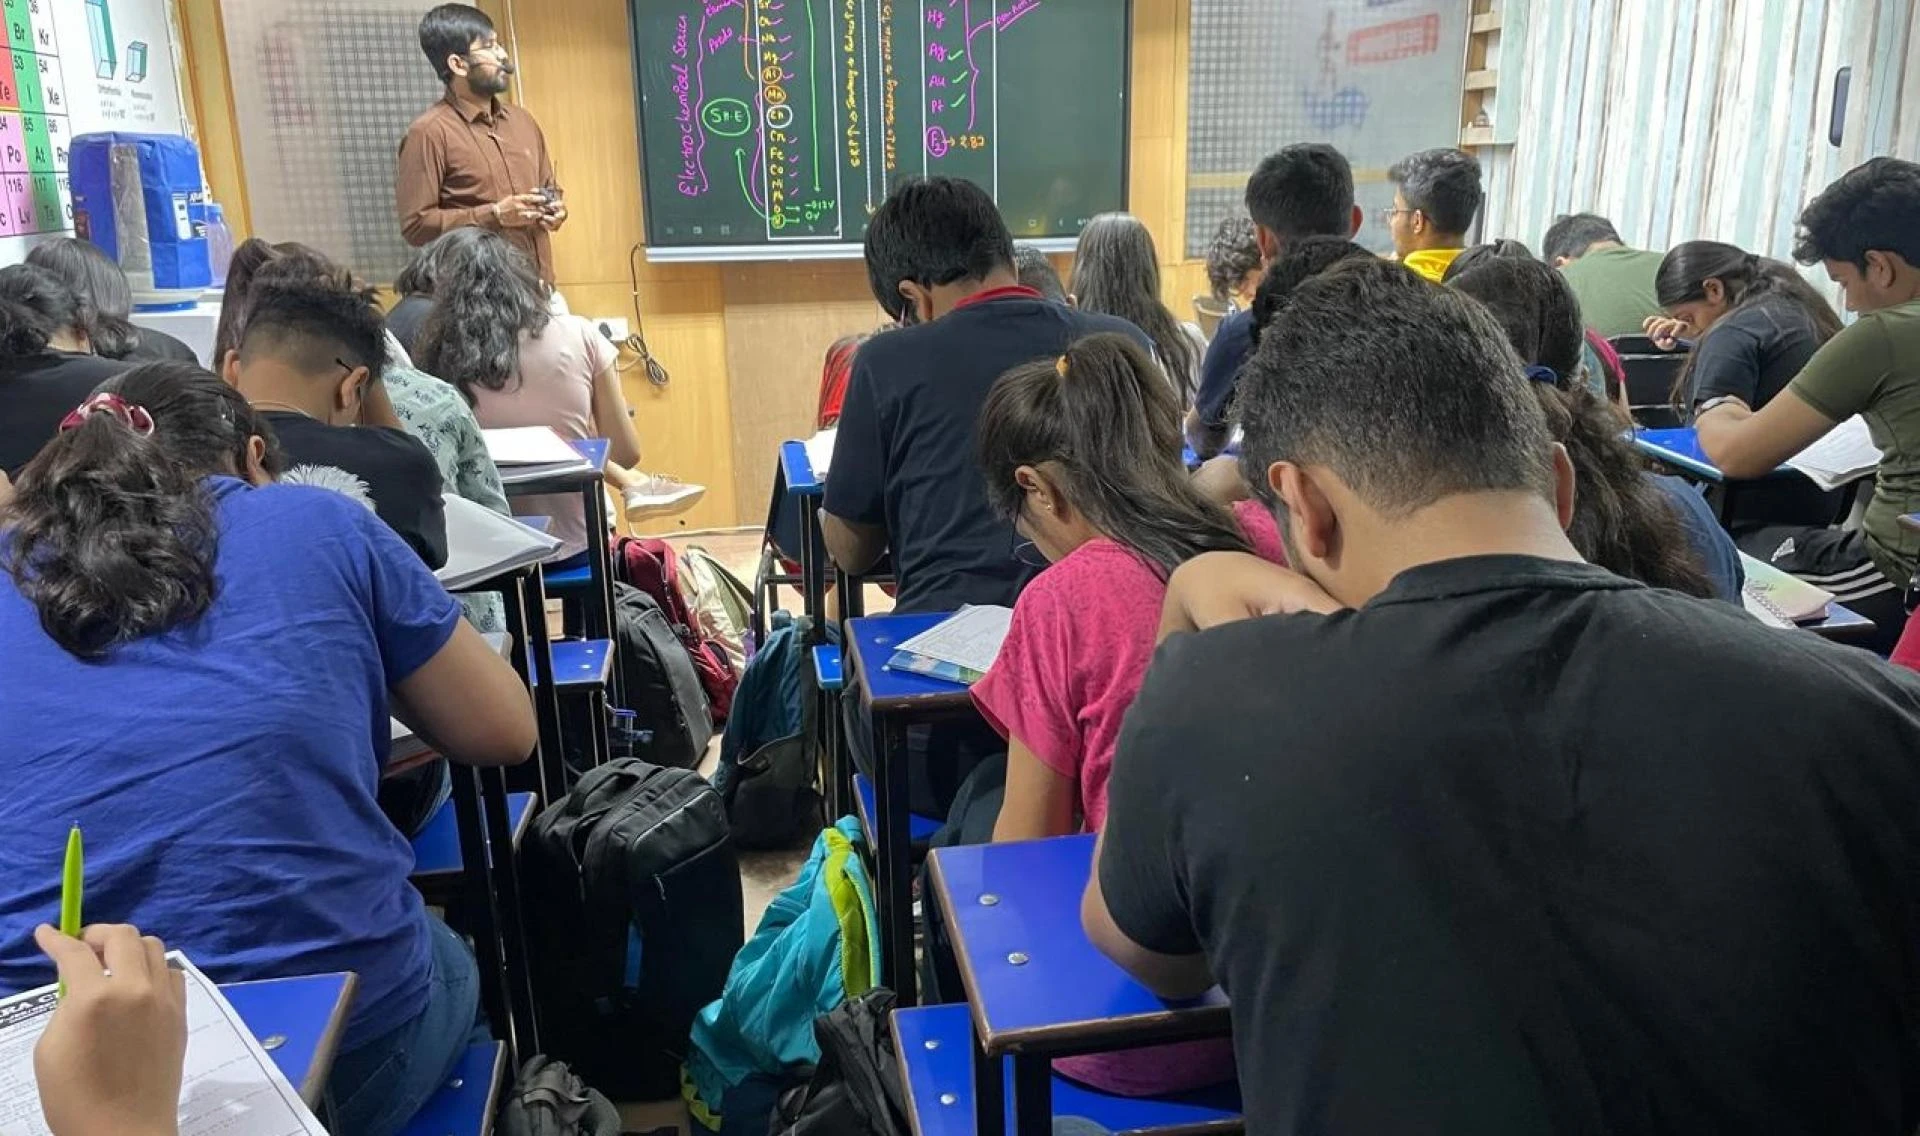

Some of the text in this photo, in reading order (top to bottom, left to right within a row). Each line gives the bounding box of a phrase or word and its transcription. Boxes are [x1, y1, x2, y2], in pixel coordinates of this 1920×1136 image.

[13, 22, 25, 41] Br
[39, 28, 49, 45] Kr
[14, 54, 25, 70] 53
[39, 59, 48, 73] 54
[47, 86, 60, 106] Xe
[7, 145, 21, 163] Po
[35, 146, 46, 163] At
[8, 178, 23, 192] 116
[18, 207, 31, 224] Lv
